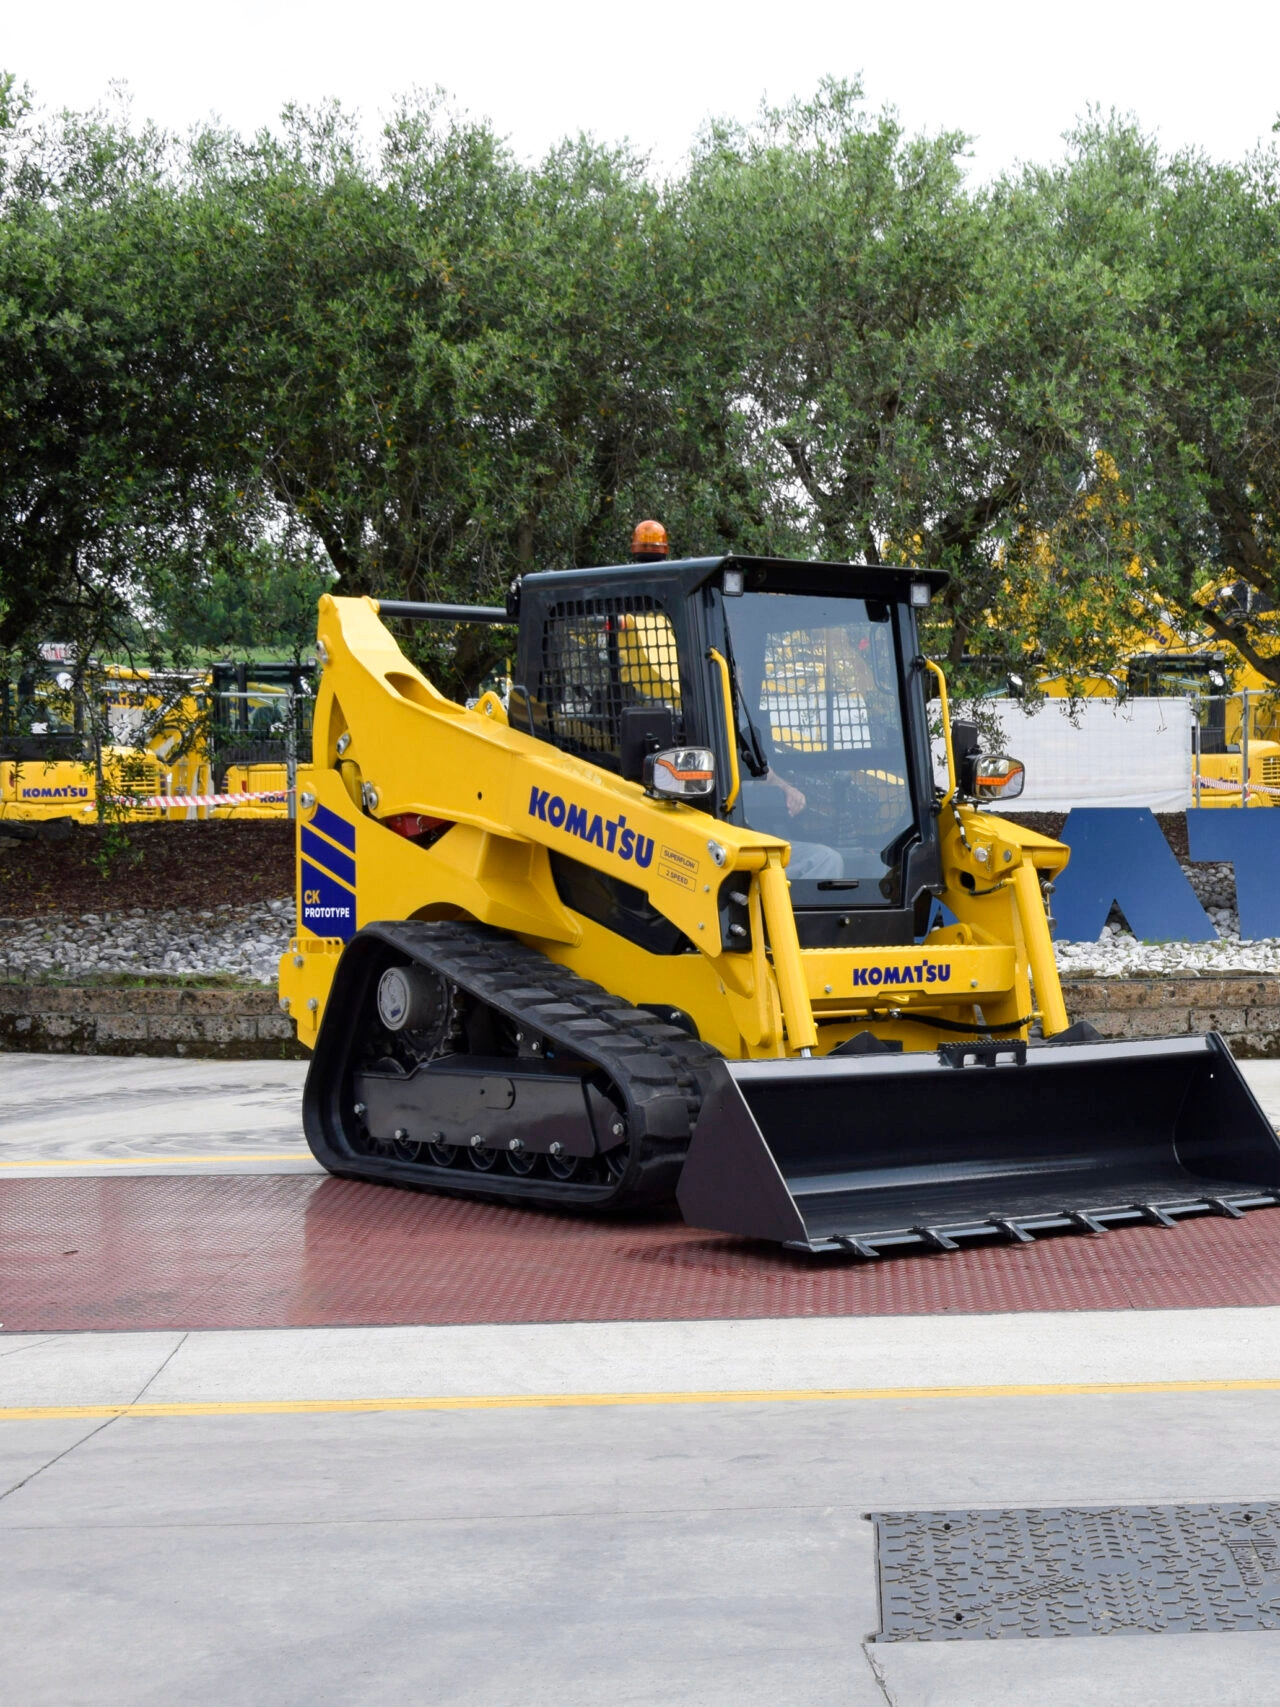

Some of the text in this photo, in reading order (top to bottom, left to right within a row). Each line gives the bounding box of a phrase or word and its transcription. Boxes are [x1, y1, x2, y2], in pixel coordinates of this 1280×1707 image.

[22, 785, 88, 798] KOMATSU
[528, 785, 655, 869] KOMATSU
[664, 849, 695, 869] SUPERFLOW
[670, 871, 688, 885] SPEED
[304, 889, 321, 905] CK
[304, 907, 350, 918] PROTOTYPE
[853, 959, 950, 986] KOMATSU
